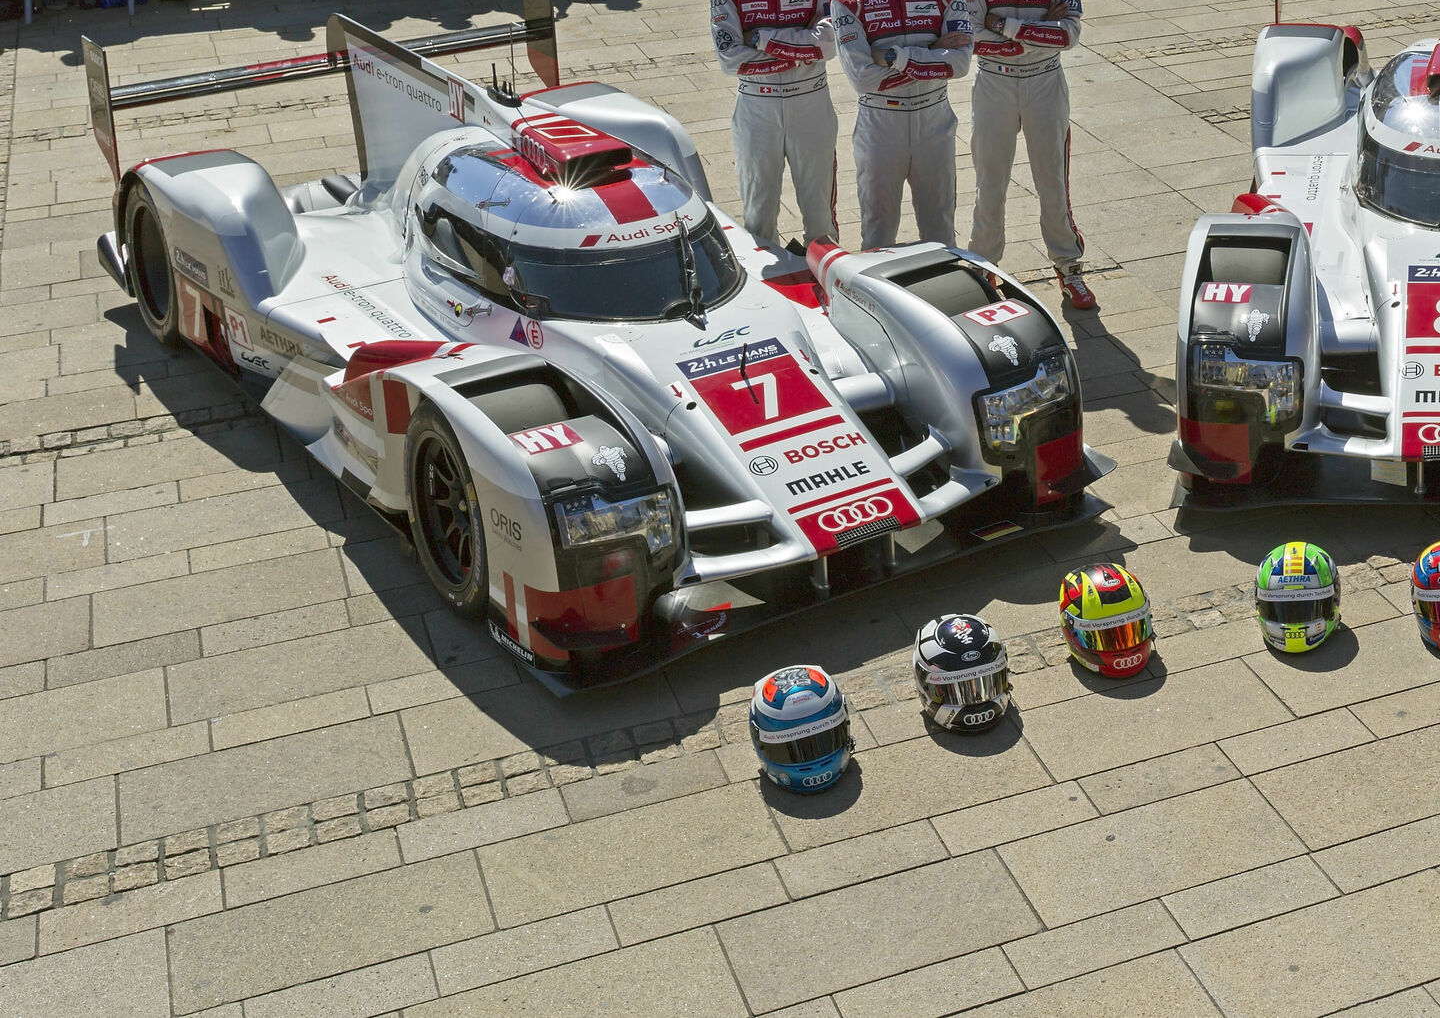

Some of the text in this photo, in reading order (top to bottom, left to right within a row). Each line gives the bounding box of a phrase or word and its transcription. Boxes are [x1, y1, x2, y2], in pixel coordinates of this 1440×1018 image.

[778, 11, 805, 22] Sport
[905, 18, 932, 28] Sport
[353, 53, 442, 112] Audi e-tron quattro
[606, 228, 649, 245] Audi
[1203, 283, 1250, 303] HY
[185, 283, 200, 339] 7
[976, 303, 1018, 322] P1
[370, 308, 412, 339] quattro
[687, 356, 717, 373] 24h
[718, 353, 737, 365] LE
[730, 372, 779, 420] 7
[512, 422, 574, 455] HY
[783, 432, 868, 465] BOSCH
[785, 460, 871, 496] MAHLE
[490, 507, 523, 541] ORIS
[1277, 575, 1311, 583] AETHRA
[1092, 618, 1126, 628] Vorsprung
[500, 632, 534, 663] MICHELIN
[942, 671, 977, 682] Vorsprung
[978, 664, 995, 675] durch
[776, 727, 811, 740] Vorsprung
[811, 721, 829, 731] durch
